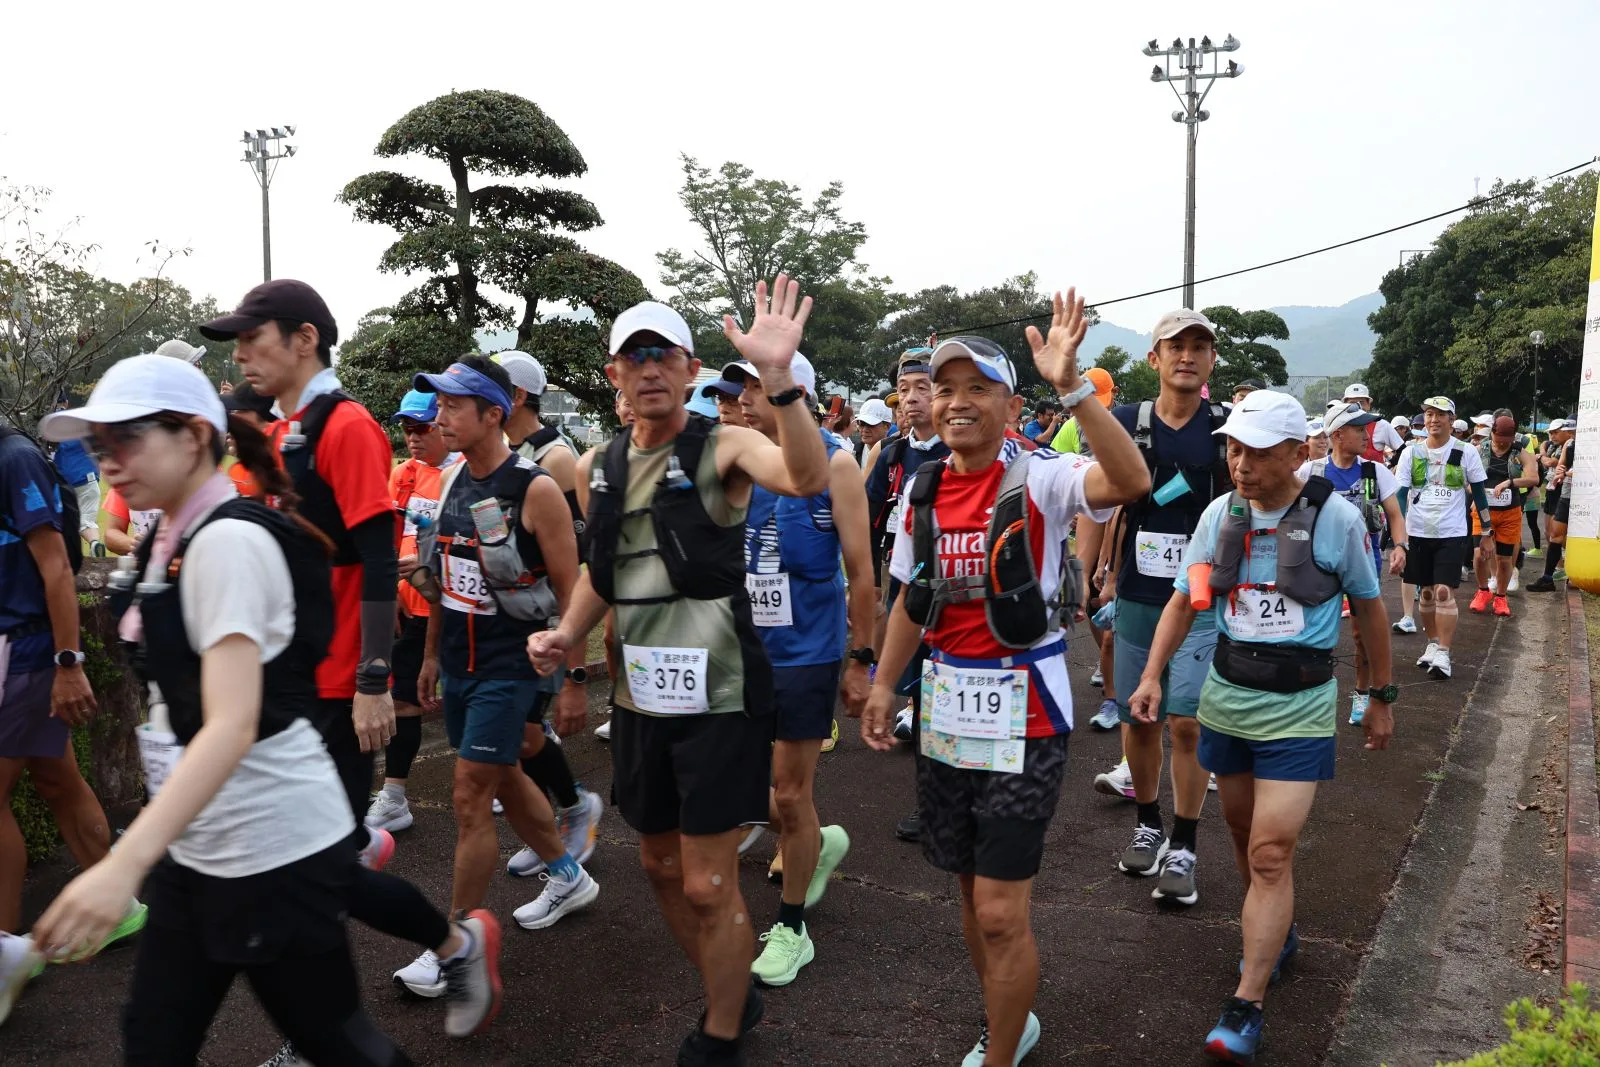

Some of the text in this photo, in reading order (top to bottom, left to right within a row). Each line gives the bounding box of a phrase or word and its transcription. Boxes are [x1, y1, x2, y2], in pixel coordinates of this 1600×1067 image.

[1434, 488, 1452, 497] 506
[1163, 547, 1182, 563] 41
[457, 575, 488, 596] 528
[750, 590, 782, 608] 449
[1259, 597, 1287, 619] 24
[655, 667, 696, 691] 376
[957, 690, 1001, 714] 119
